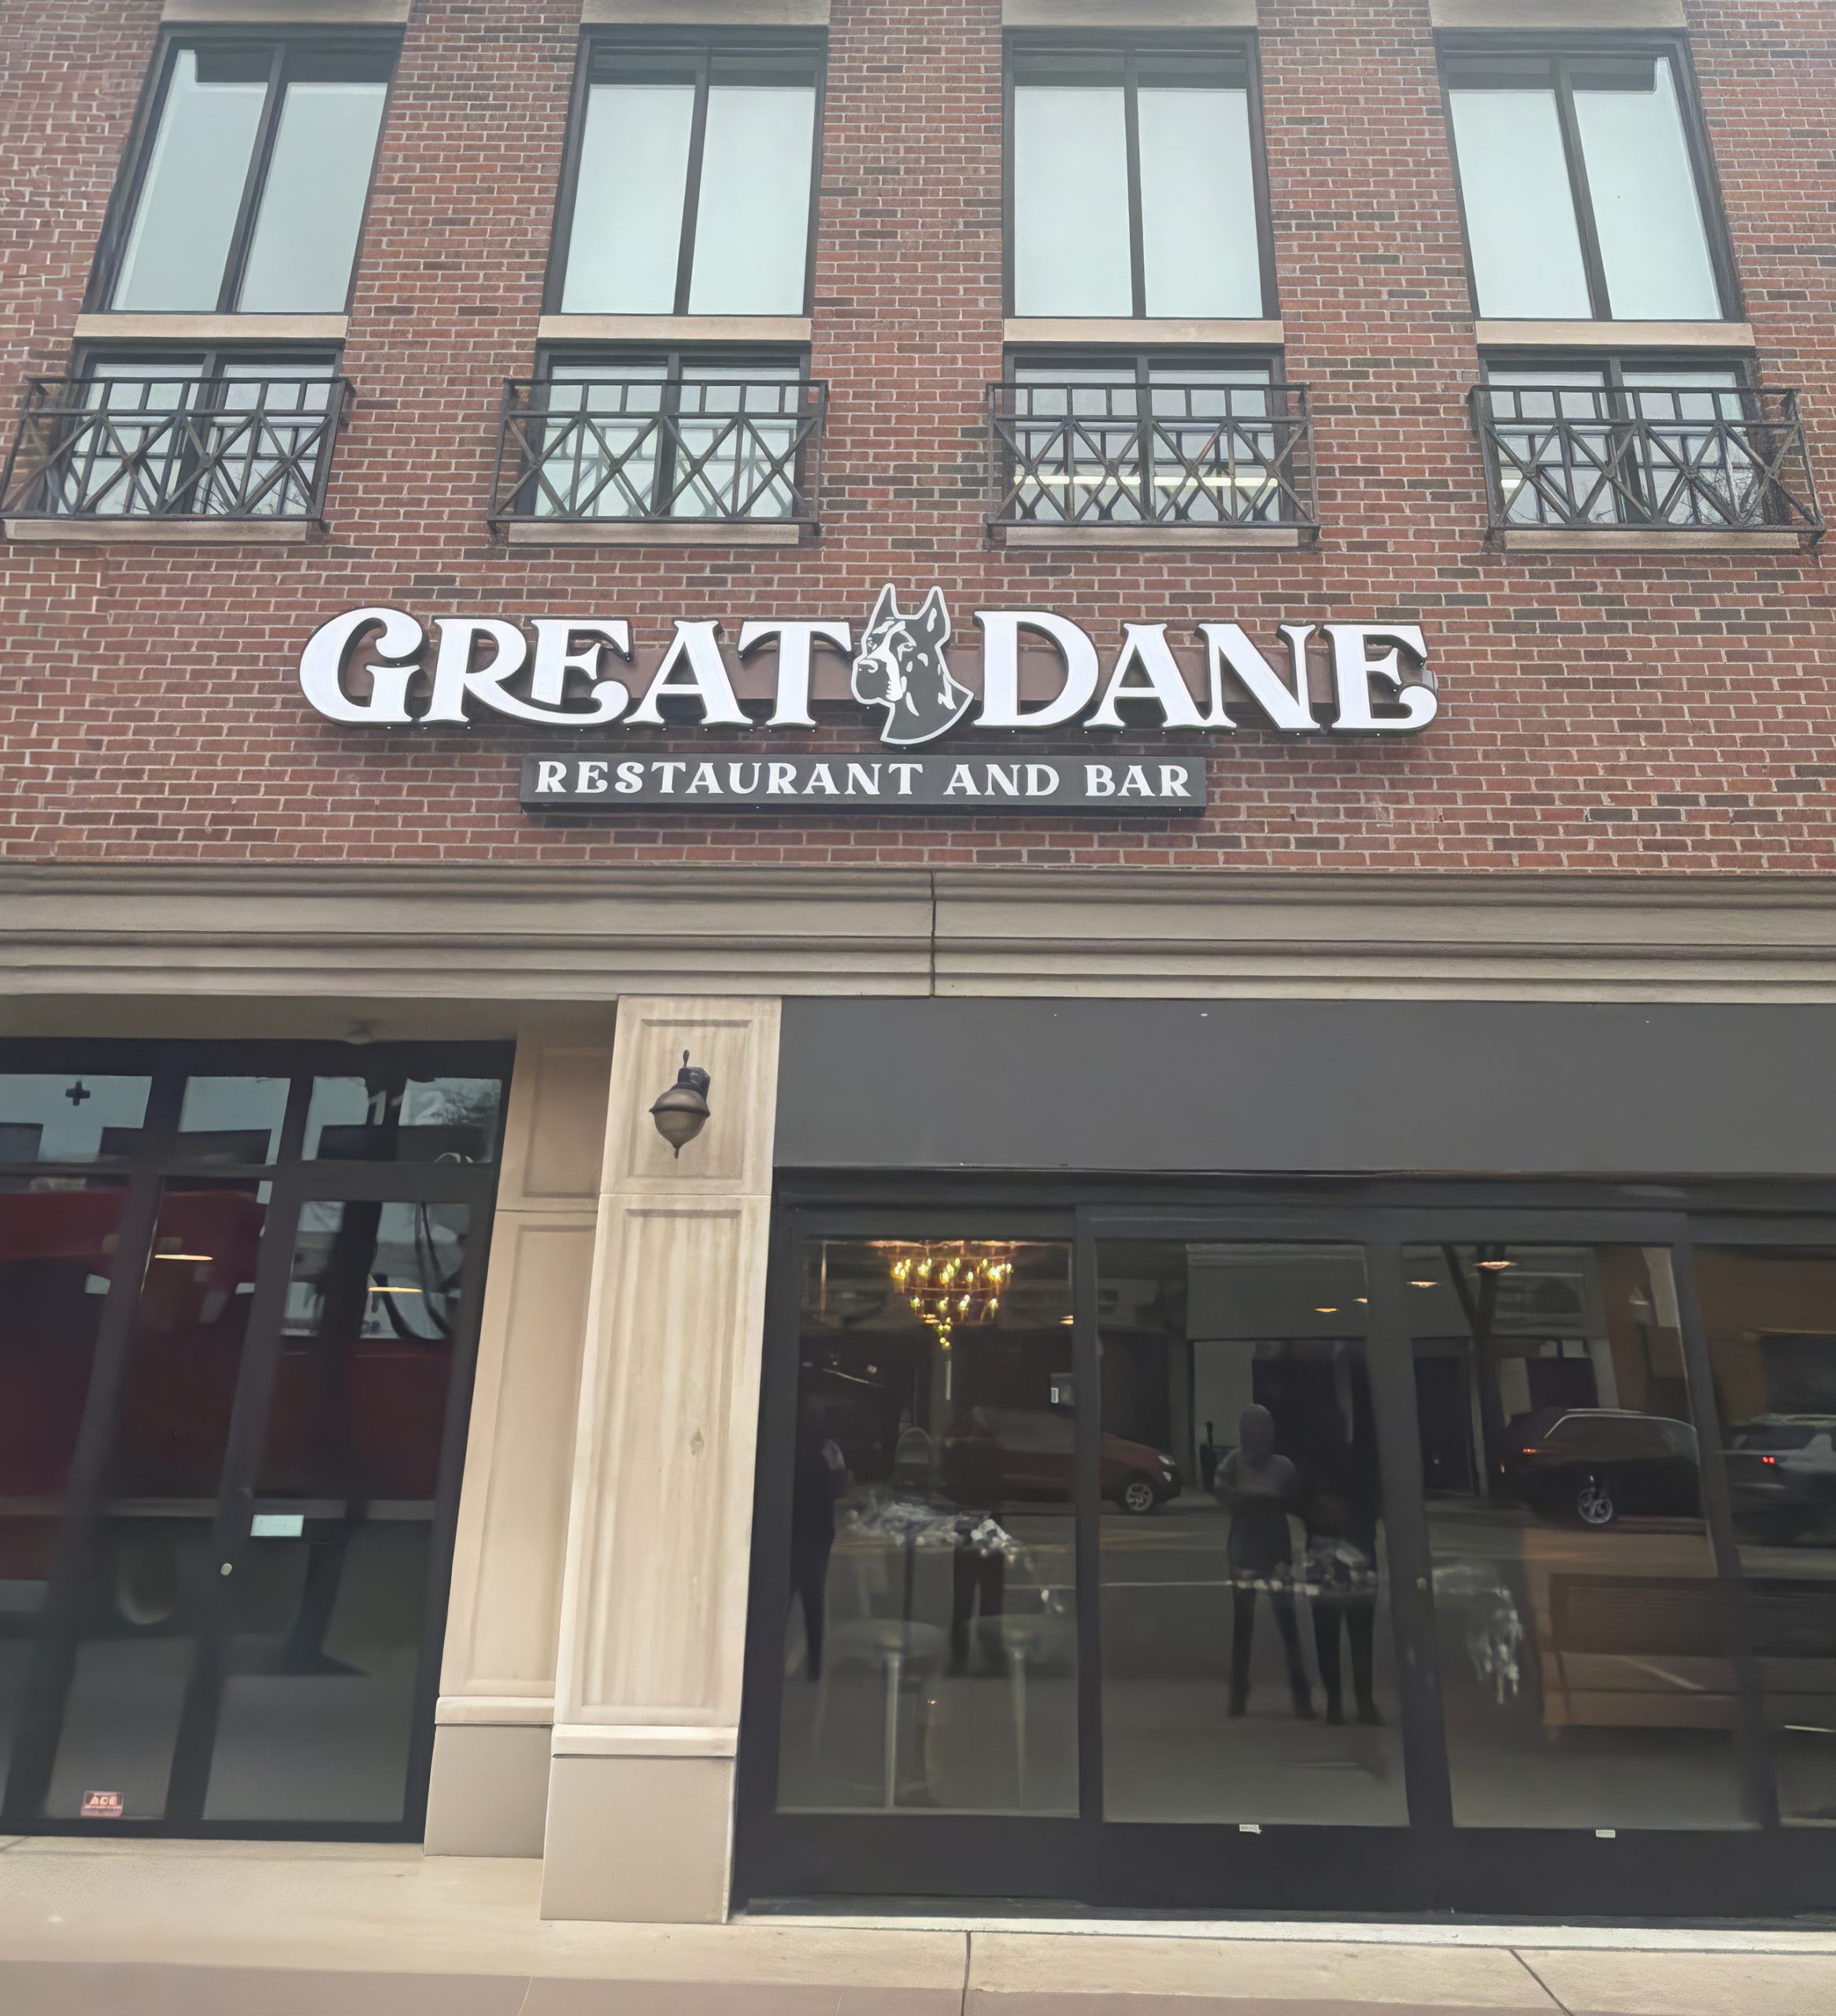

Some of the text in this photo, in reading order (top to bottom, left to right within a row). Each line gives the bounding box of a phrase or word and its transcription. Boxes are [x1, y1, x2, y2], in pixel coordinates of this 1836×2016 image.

[298, 607, 1438, 732] GREAT DANE
[535, 761, 1192, 798] RESTAURANT AND BAR
